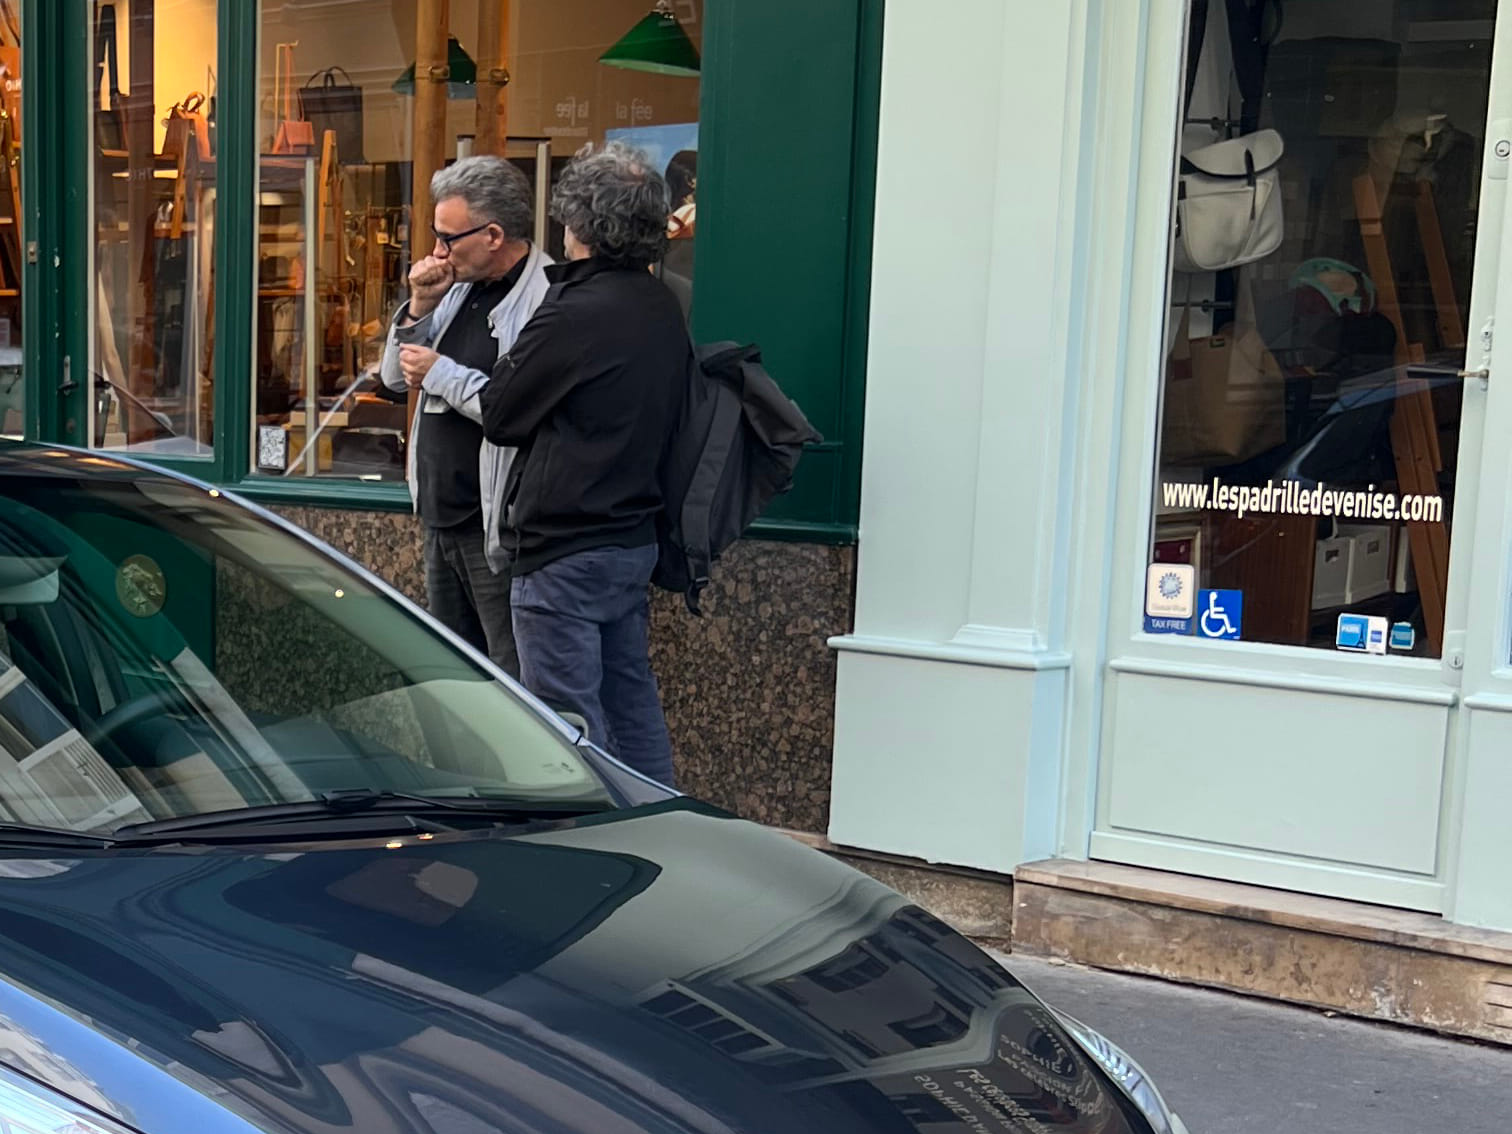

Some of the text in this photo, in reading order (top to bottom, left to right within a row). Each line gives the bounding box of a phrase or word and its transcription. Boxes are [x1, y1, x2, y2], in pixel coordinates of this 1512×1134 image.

[1163, 477, 1443, 523] www.lespadrilledevenise.com
[1151, 619, 1186, 631] TAX FREE
